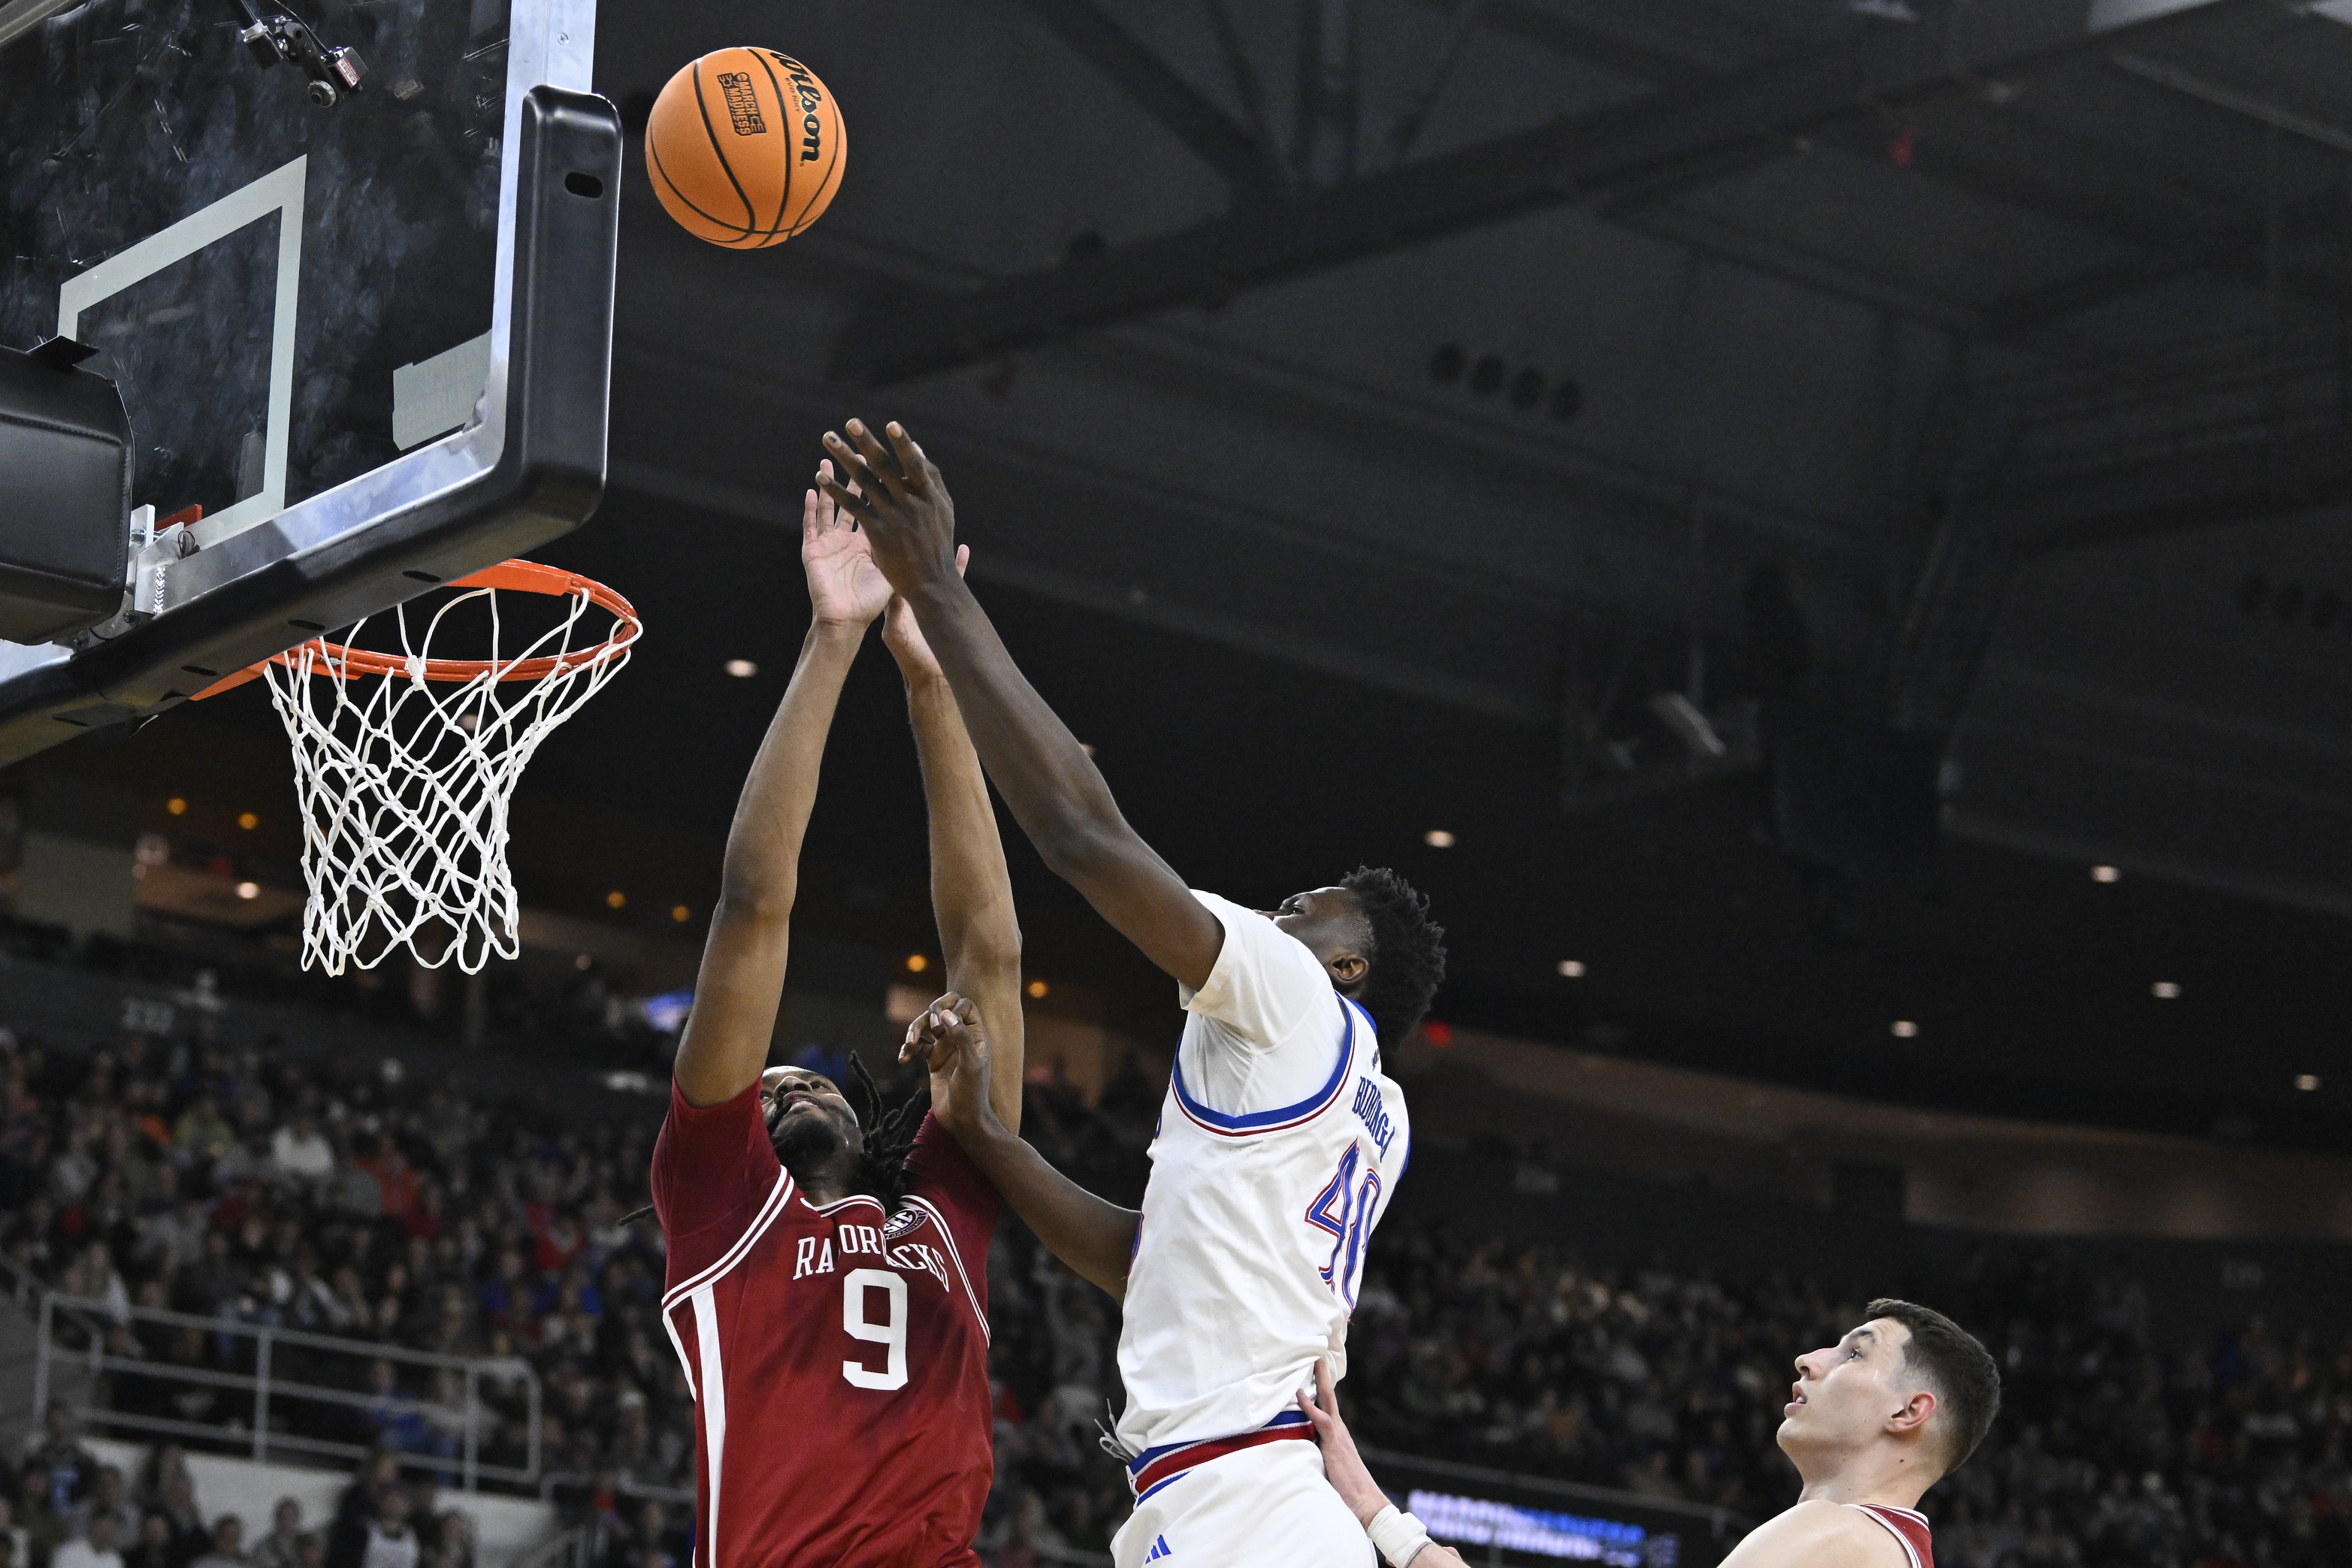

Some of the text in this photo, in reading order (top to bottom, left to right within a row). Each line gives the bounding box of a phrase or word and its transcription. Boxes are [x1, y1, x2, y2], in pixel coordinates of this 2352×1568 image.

[726, 87, 752, 134] MADNESS
[736, 80, 759, 115] MARCH
[883, 1211, 914, 1234] SEC
[1304, 1136, 1383, 1313] 40
[842, 1268, 908, 1391] 9
